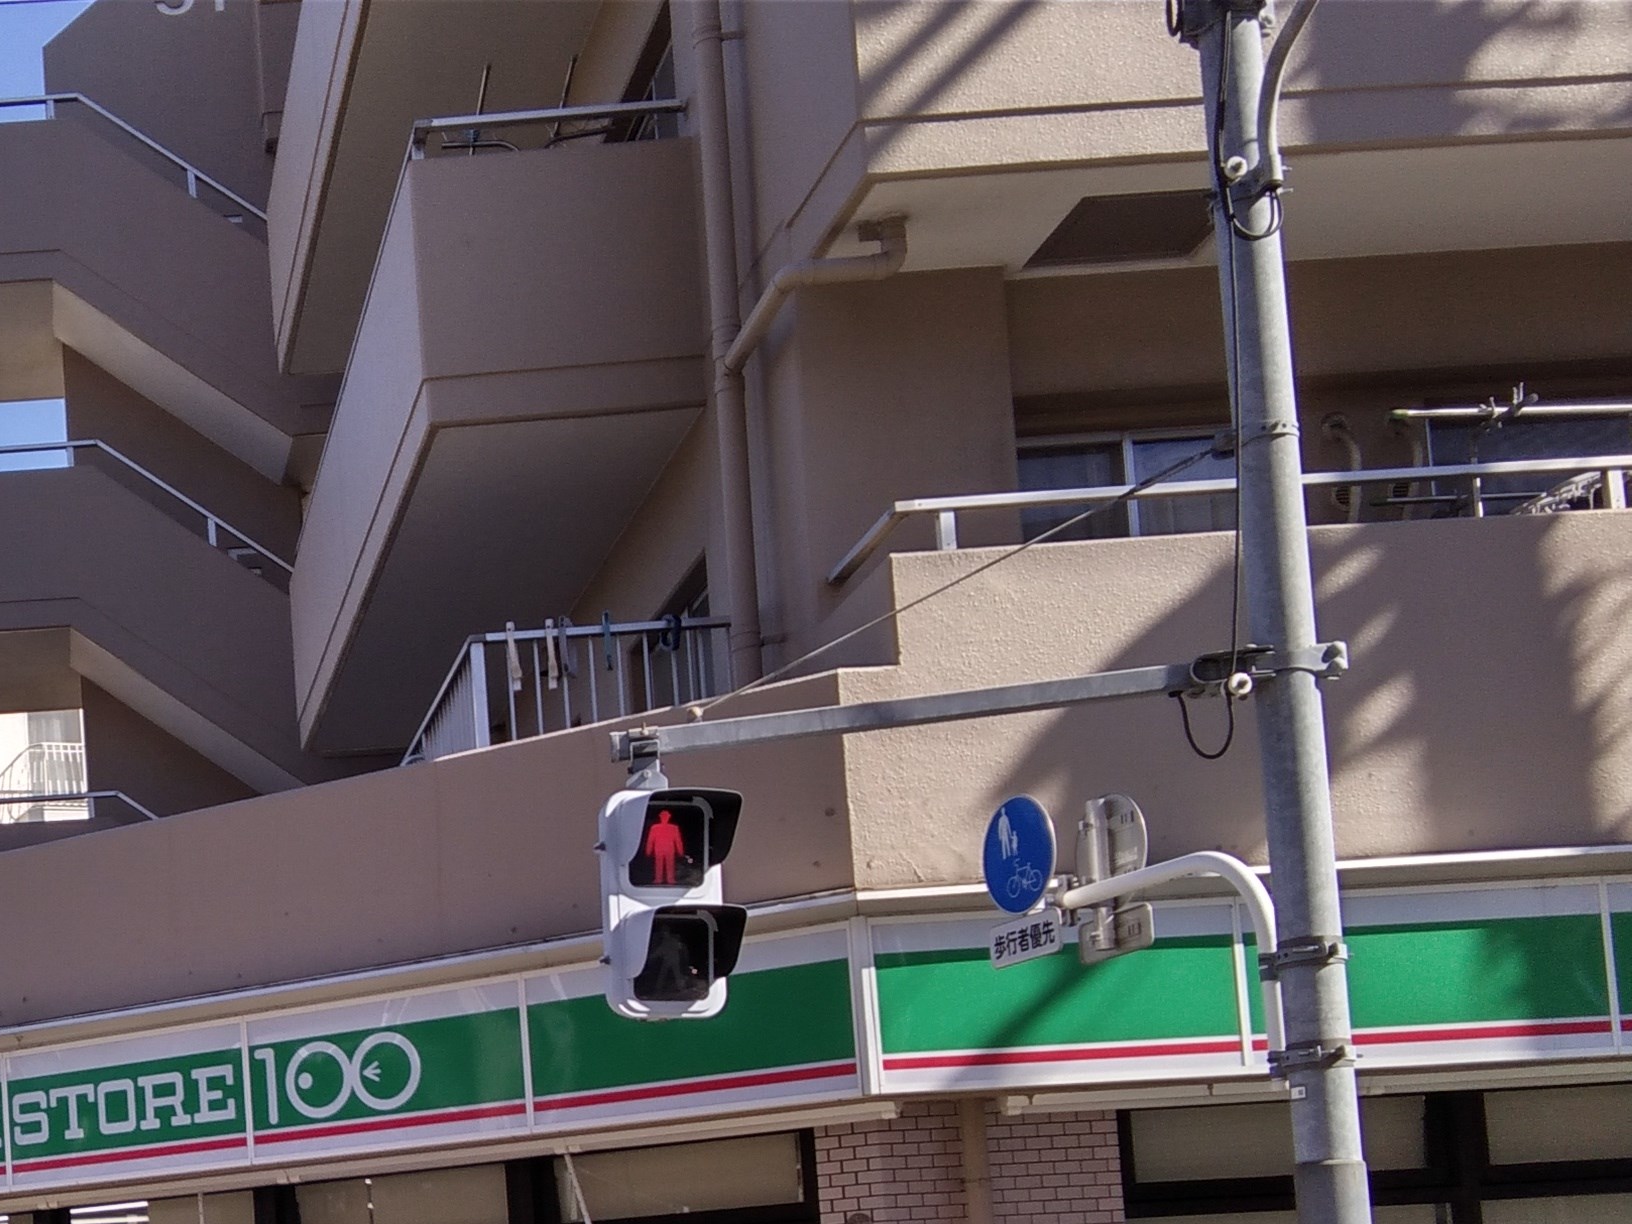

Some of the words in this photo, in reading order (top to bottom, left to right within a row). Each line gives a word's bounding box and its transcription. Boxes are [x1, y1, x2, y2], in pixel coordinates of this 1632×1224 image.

[994, 920, 1055, 960] 歩行者優先
[13, 1064, 236, 1146] STORE
[254, 1031, 421, 1125] 100
